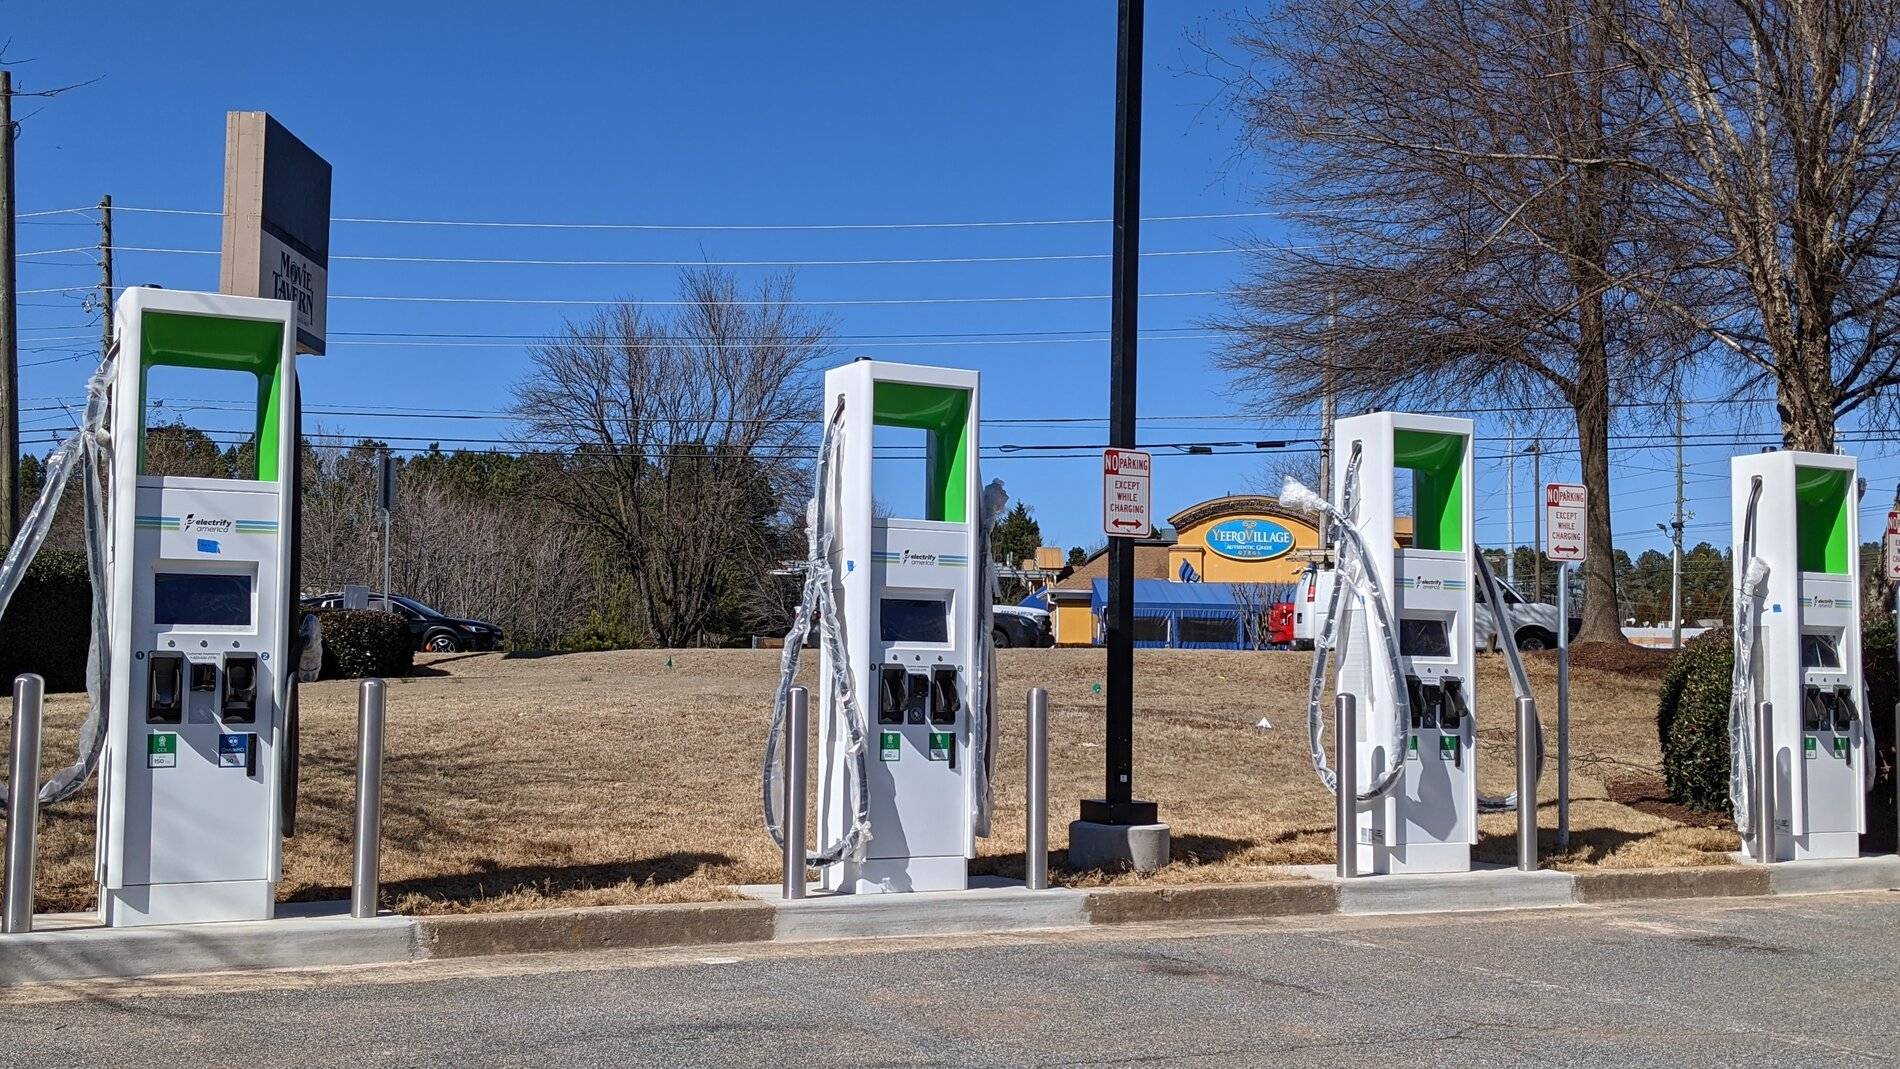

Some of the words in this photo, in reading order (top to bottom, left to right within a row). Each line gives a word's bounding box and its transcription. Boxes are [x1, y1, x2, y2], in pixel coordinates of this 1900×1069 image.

[272, 271, 314, 326] TAVERN
[1105, 454, 1118, 471] NO
[1119, 457, 1148, 471] PARKING
[1114, 480, 1141, 491] EXCEPT
[1117, 492, 1138, 502] WHILE
[1547, 488, 1559, 504] NO
[1559, 491, 1584, 503] PARKING
[1110, 503, 1145, 514] CHARGING
[1555, 511, 1578, 520] EXCEPT
[195, 518, 232, 528] electrify
[1557, 522, 1576, 531] WHILE
[196, 526, 229, 534] america
[1552, 532, 1582, 541] CHARGING
[910, 553, 937, 562] electrify
